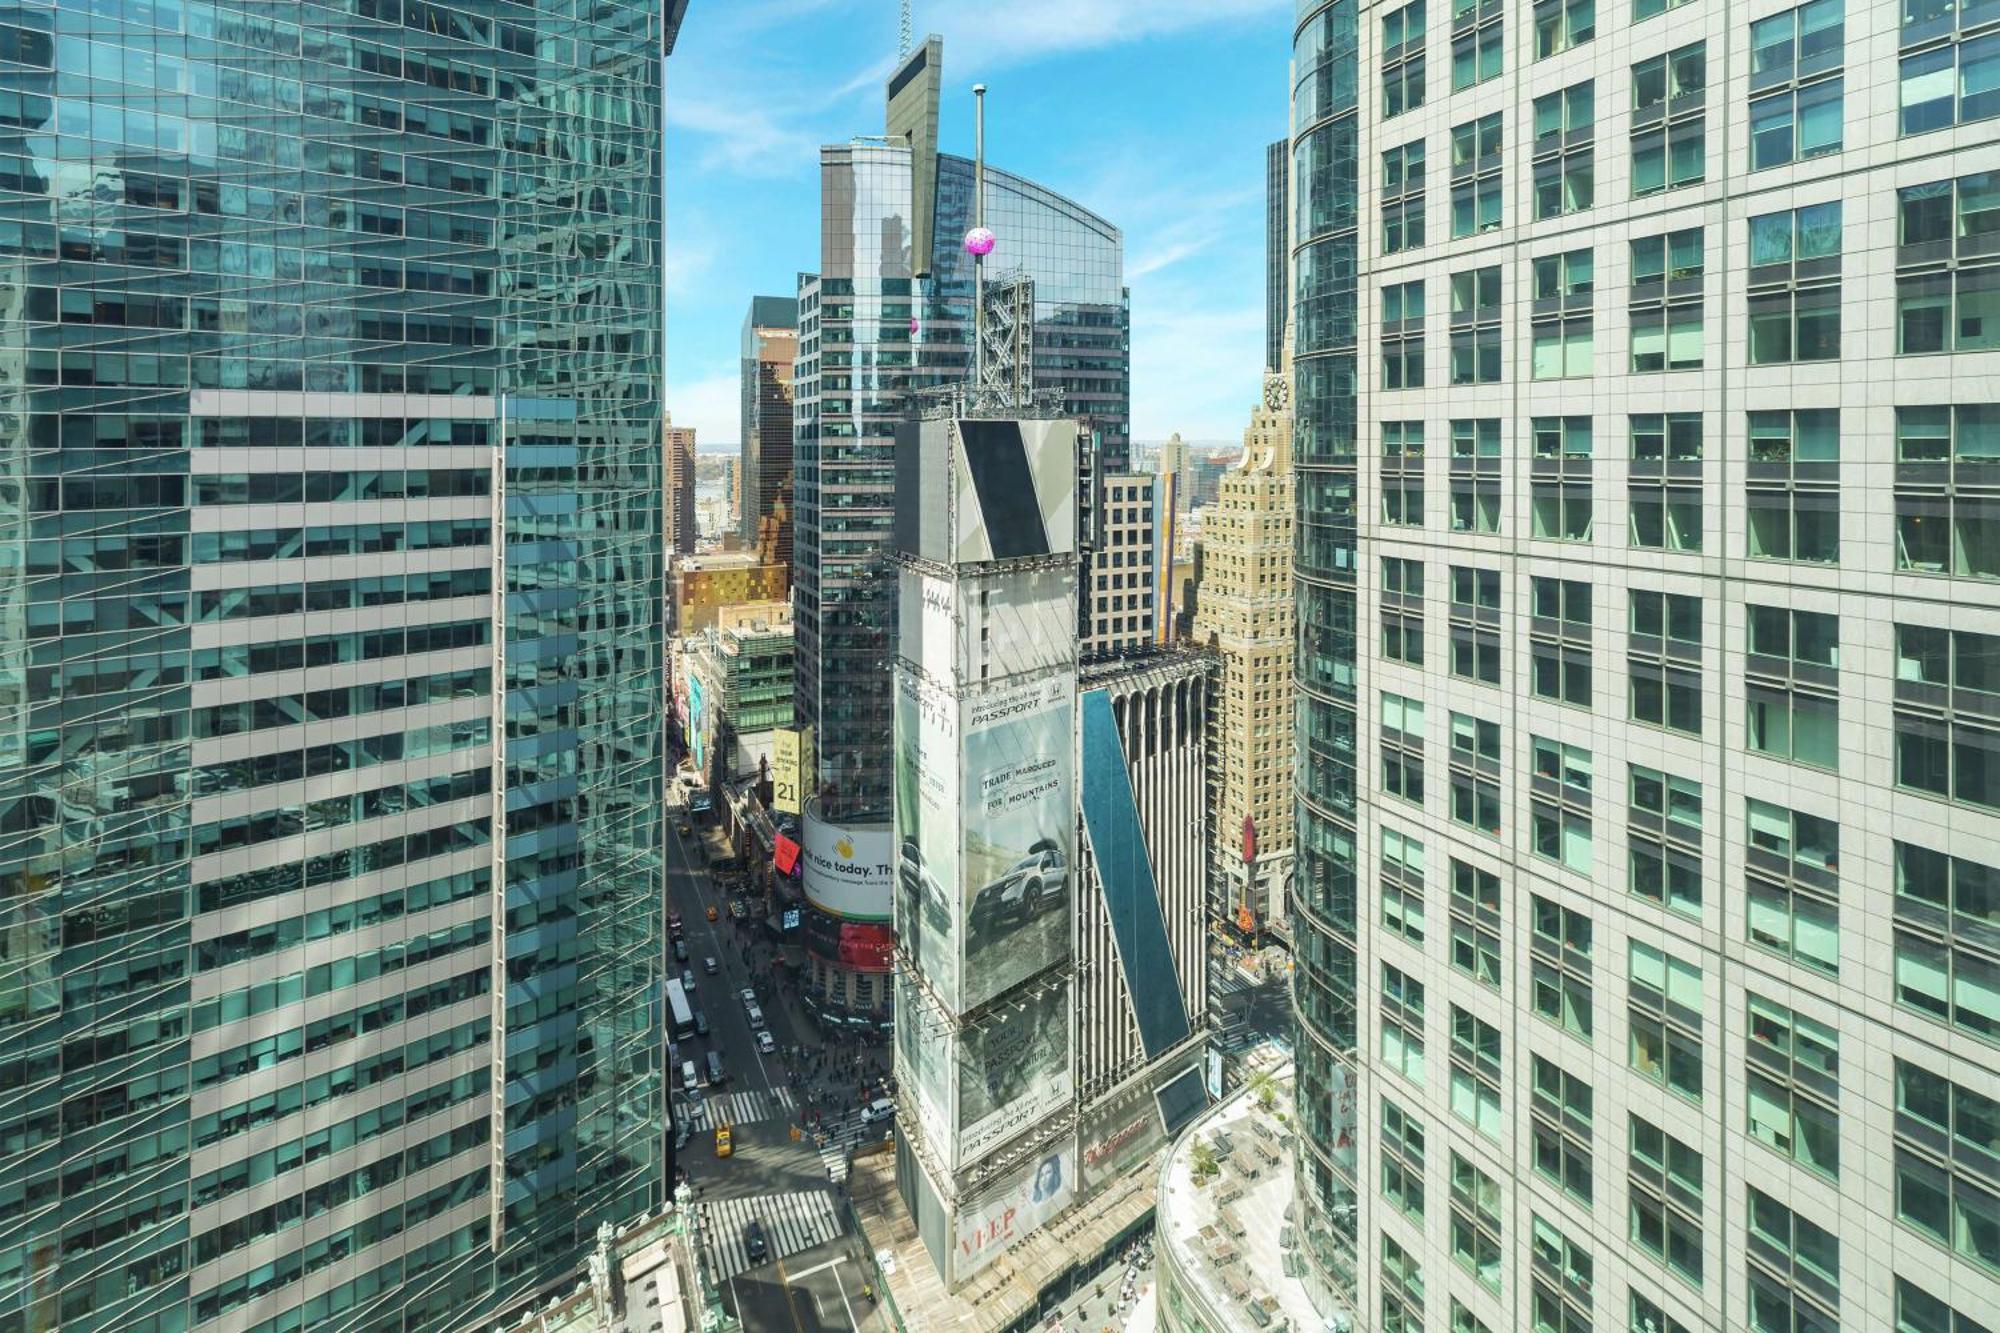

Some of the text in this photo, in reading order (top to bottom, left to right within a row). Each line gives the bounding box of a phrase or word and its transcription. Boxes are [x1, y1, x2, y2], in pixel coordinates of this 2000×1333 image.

[971, 699, 1039, 727] PASSPORT
[777, 782, 796, 802] 21
[982, 771, 1012, 790] TRADE
[987, 779, 1059, 811] FOR MOUNTAINS
[814, 855, 833, 870] nice
[834, 861, 872, 878] today.
[962, 1105, 1036, 1157] PASSPORT
